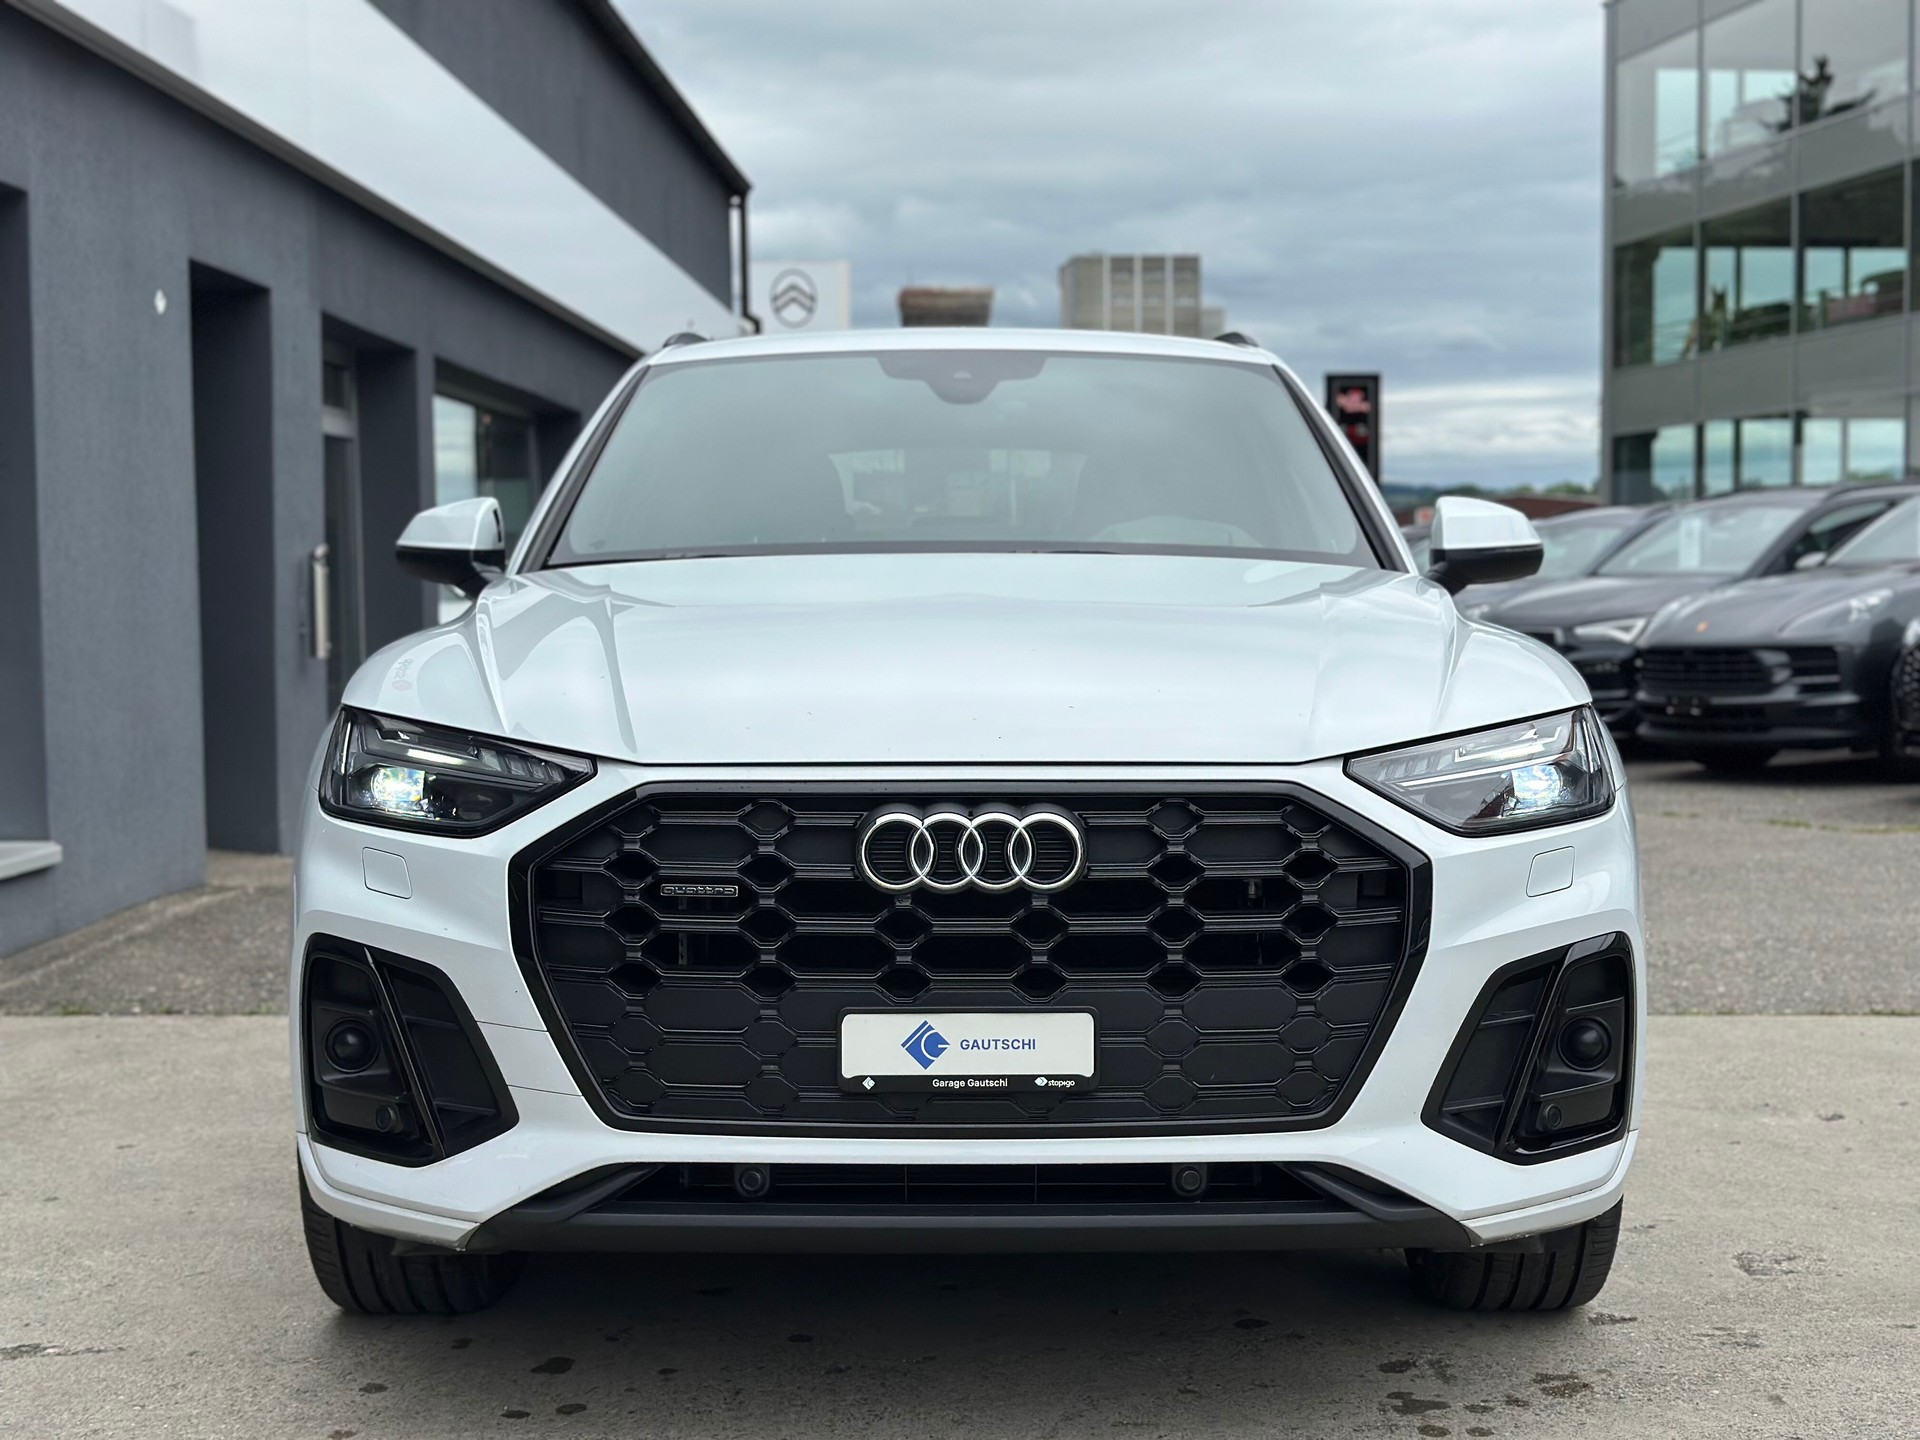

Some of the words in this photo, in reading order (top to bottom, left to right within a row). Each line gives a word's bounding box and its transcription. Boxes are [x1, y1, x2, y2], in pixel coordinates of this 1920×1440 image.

[662, 886, 736, 896] quattro
[959, 1038, 1036, 1051] GAUTSCHI
[932, 1078, 966, 1089] Garage
[967, 1077, 1008, 1088] Gautschi
